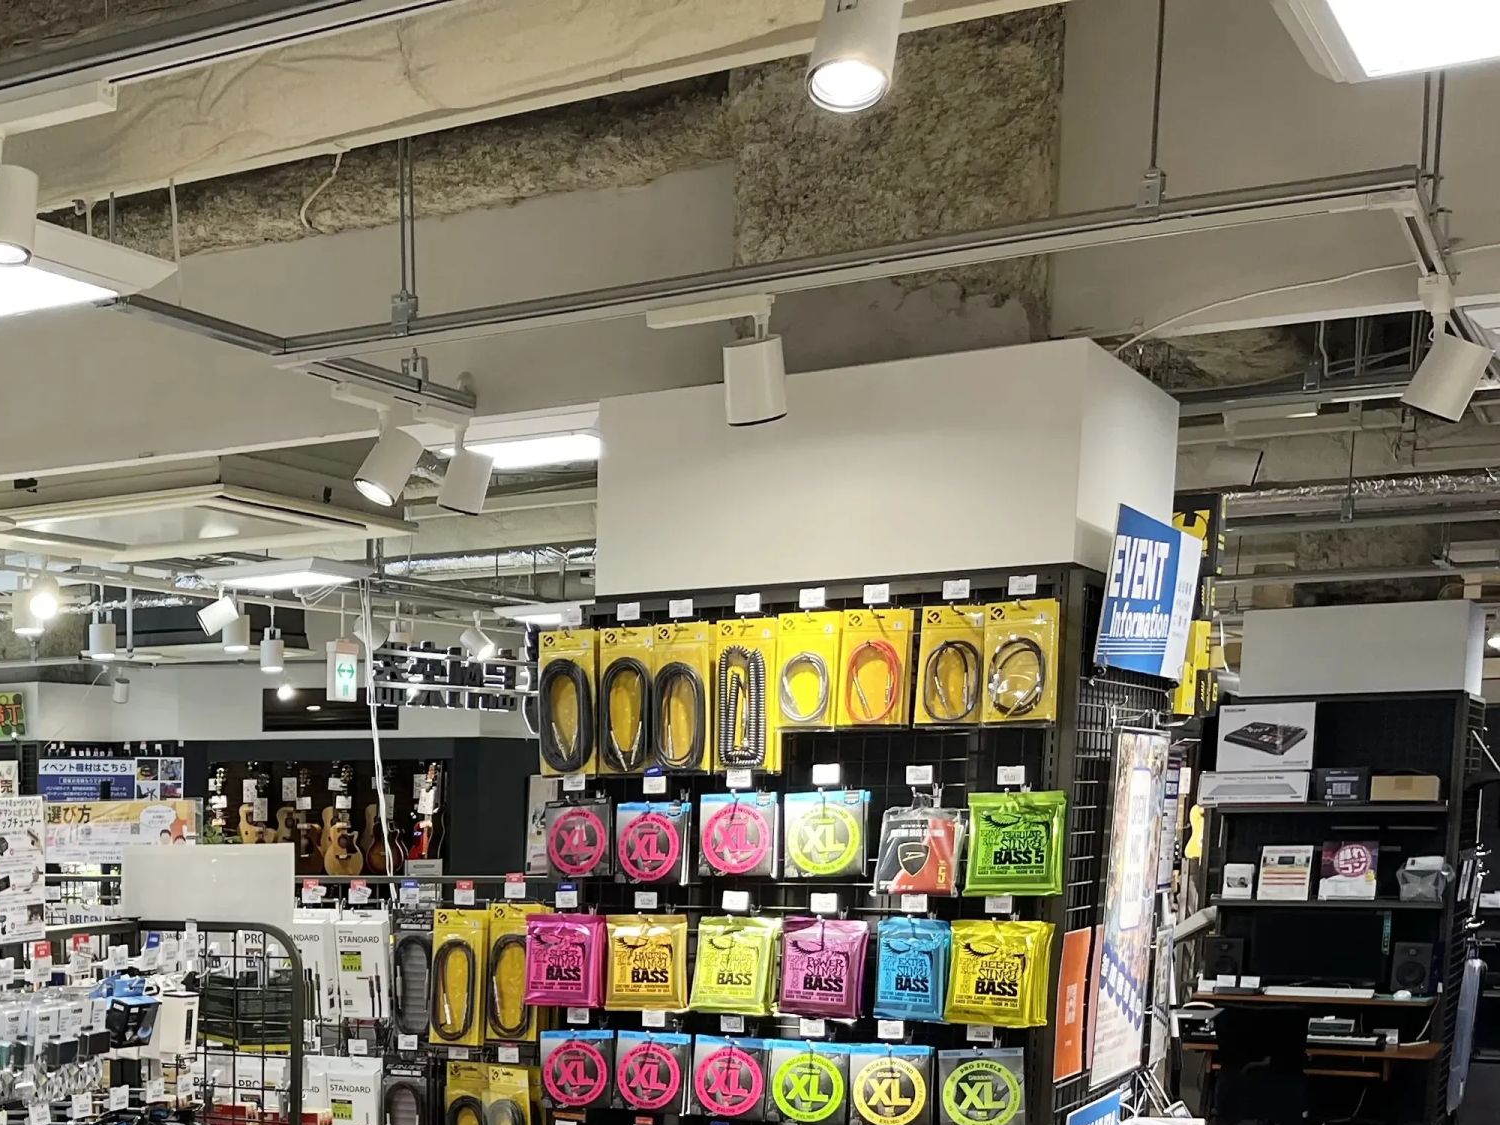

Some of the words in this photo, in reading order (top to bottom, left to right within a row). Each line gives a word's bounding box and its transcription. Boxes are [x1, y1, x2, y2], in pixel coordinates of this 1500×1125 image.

[1108, 534, 1170, 601] EVENT
[1110, 601, 1170, 640] Information
[47, 804, 92, 825] 選び方
[560, 828, 597, 855] XL
[630, 834, 667, 861] XL
[715, 823, 757, 852] XL
[802, 825, 845, 853] XL
[993, 850, 1033, 866] BASS
[1034, 850, 1045, 864] 5
[288, 934, 320, 943] ANDARD
[338, 935, 379, 944] STANDARD
[806, 956, 845, 968] POWER
[545, 967, 581, 982] BASS
[631, 969, 669, 984] BASS
[716, 972, 752, 986] BASS
[803, 977, 844, 993] BASS
[895, 978, 929, 993] BASS
[974, 980, 1019, 998] BASS
[556, 1059, 595, 1087] XL
[628, 1063, 667, 1091] XL
[959, 1062, 976, 1075] PRO
[976, 1062, 1003, 1074] STEELS
[329, 1083, 371, 1094] STANDARD
[707, 1067, 750, 1097] XL
[785, 1071, 829, 1103] XL
[867, 1077, 912, 1107] XL
[957, 1081, 1006, 1111] XL
